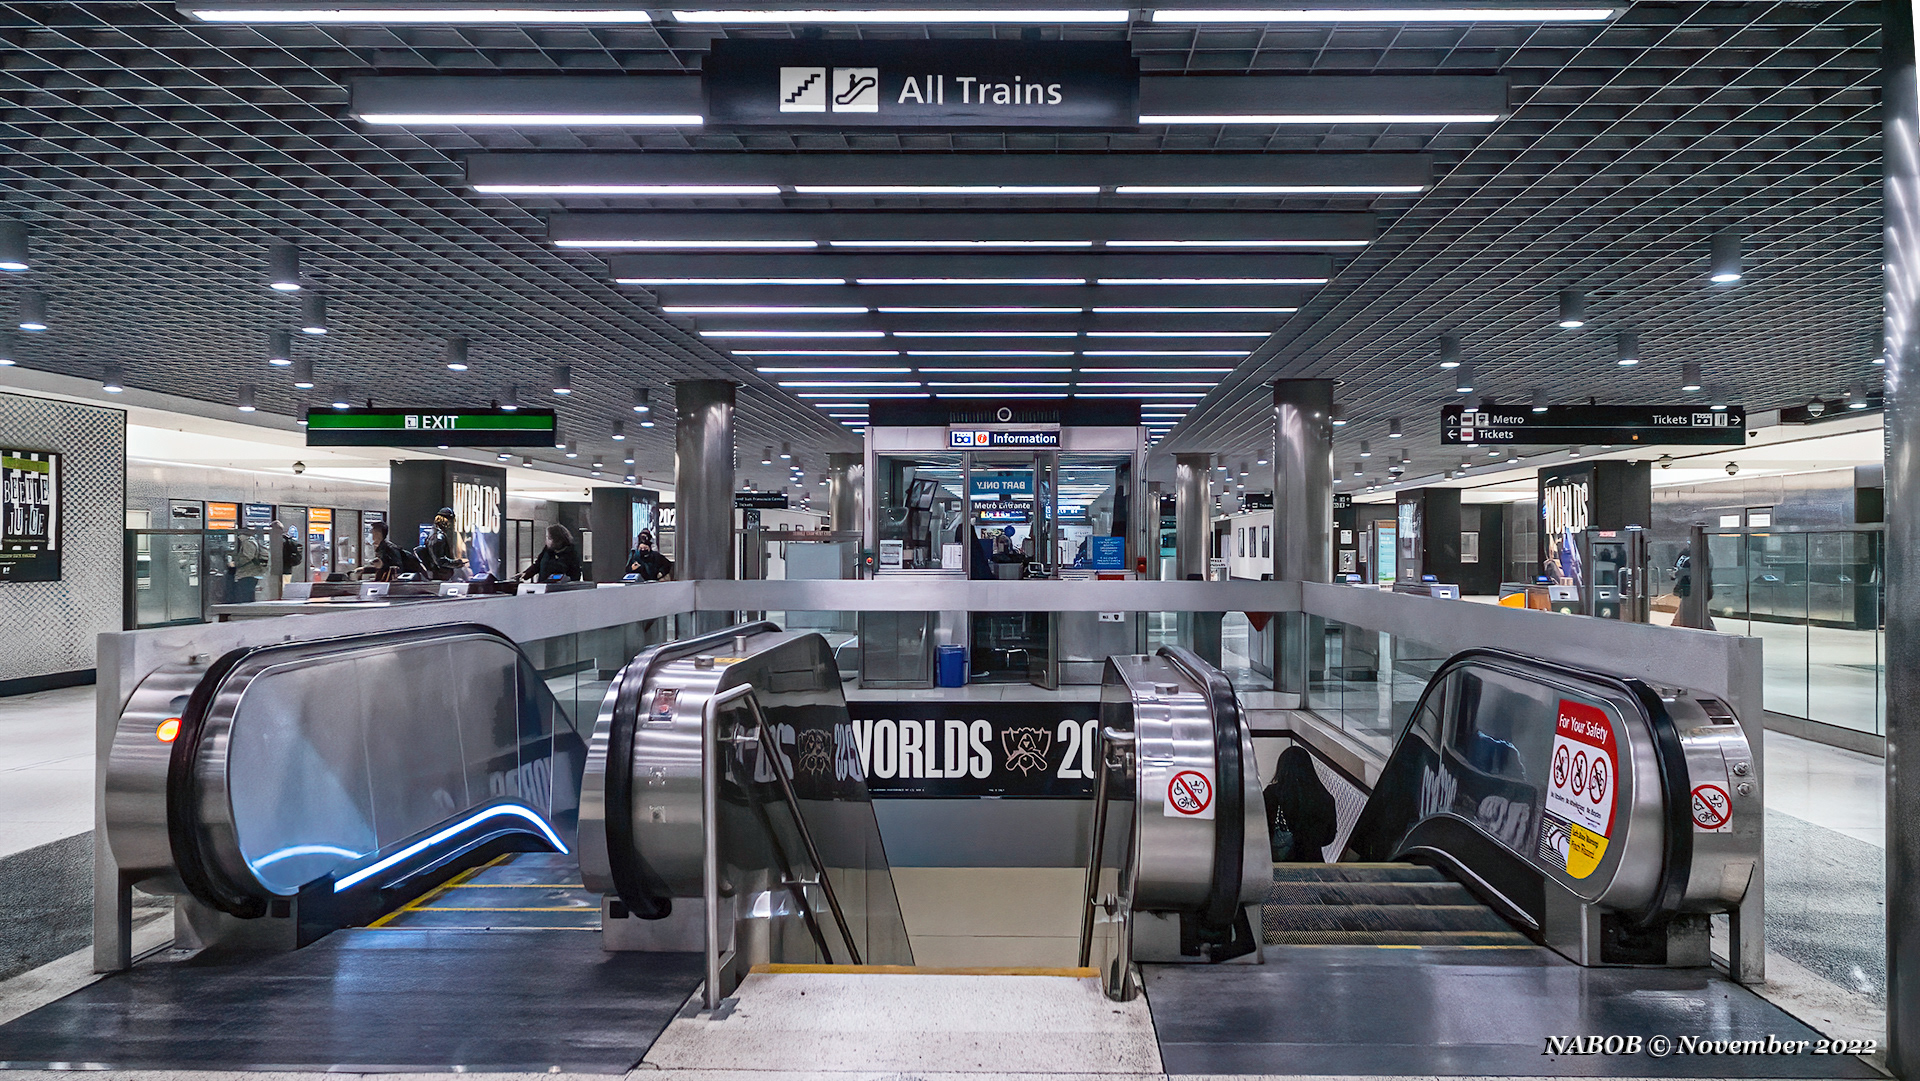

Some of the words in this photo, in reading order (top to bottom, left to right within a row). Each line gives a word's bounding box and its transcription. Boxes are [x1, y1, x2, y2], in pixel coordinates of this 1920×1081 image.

[899, 75, 943, 105] All
[956, 75, 1062, 105] Trains
[423, 415, 459, 429] EXIT
[1492, 414, 1525, 424] Metro
[1652, 414, 1687, 424] Tickets
[993, 433, 1057, 444] Information
[1479, 430, 1513, 439] Tickets
[4, 473, 49, 505] BEETLE
[453, 482, 501, 534] WORLDS
[1544, 482, 1589, 534] WORLDS
[1559, 713, 1570, 728] For
[1571, 716, 1586, 734] Your
[1586, 720, 1608, 745] Safety
